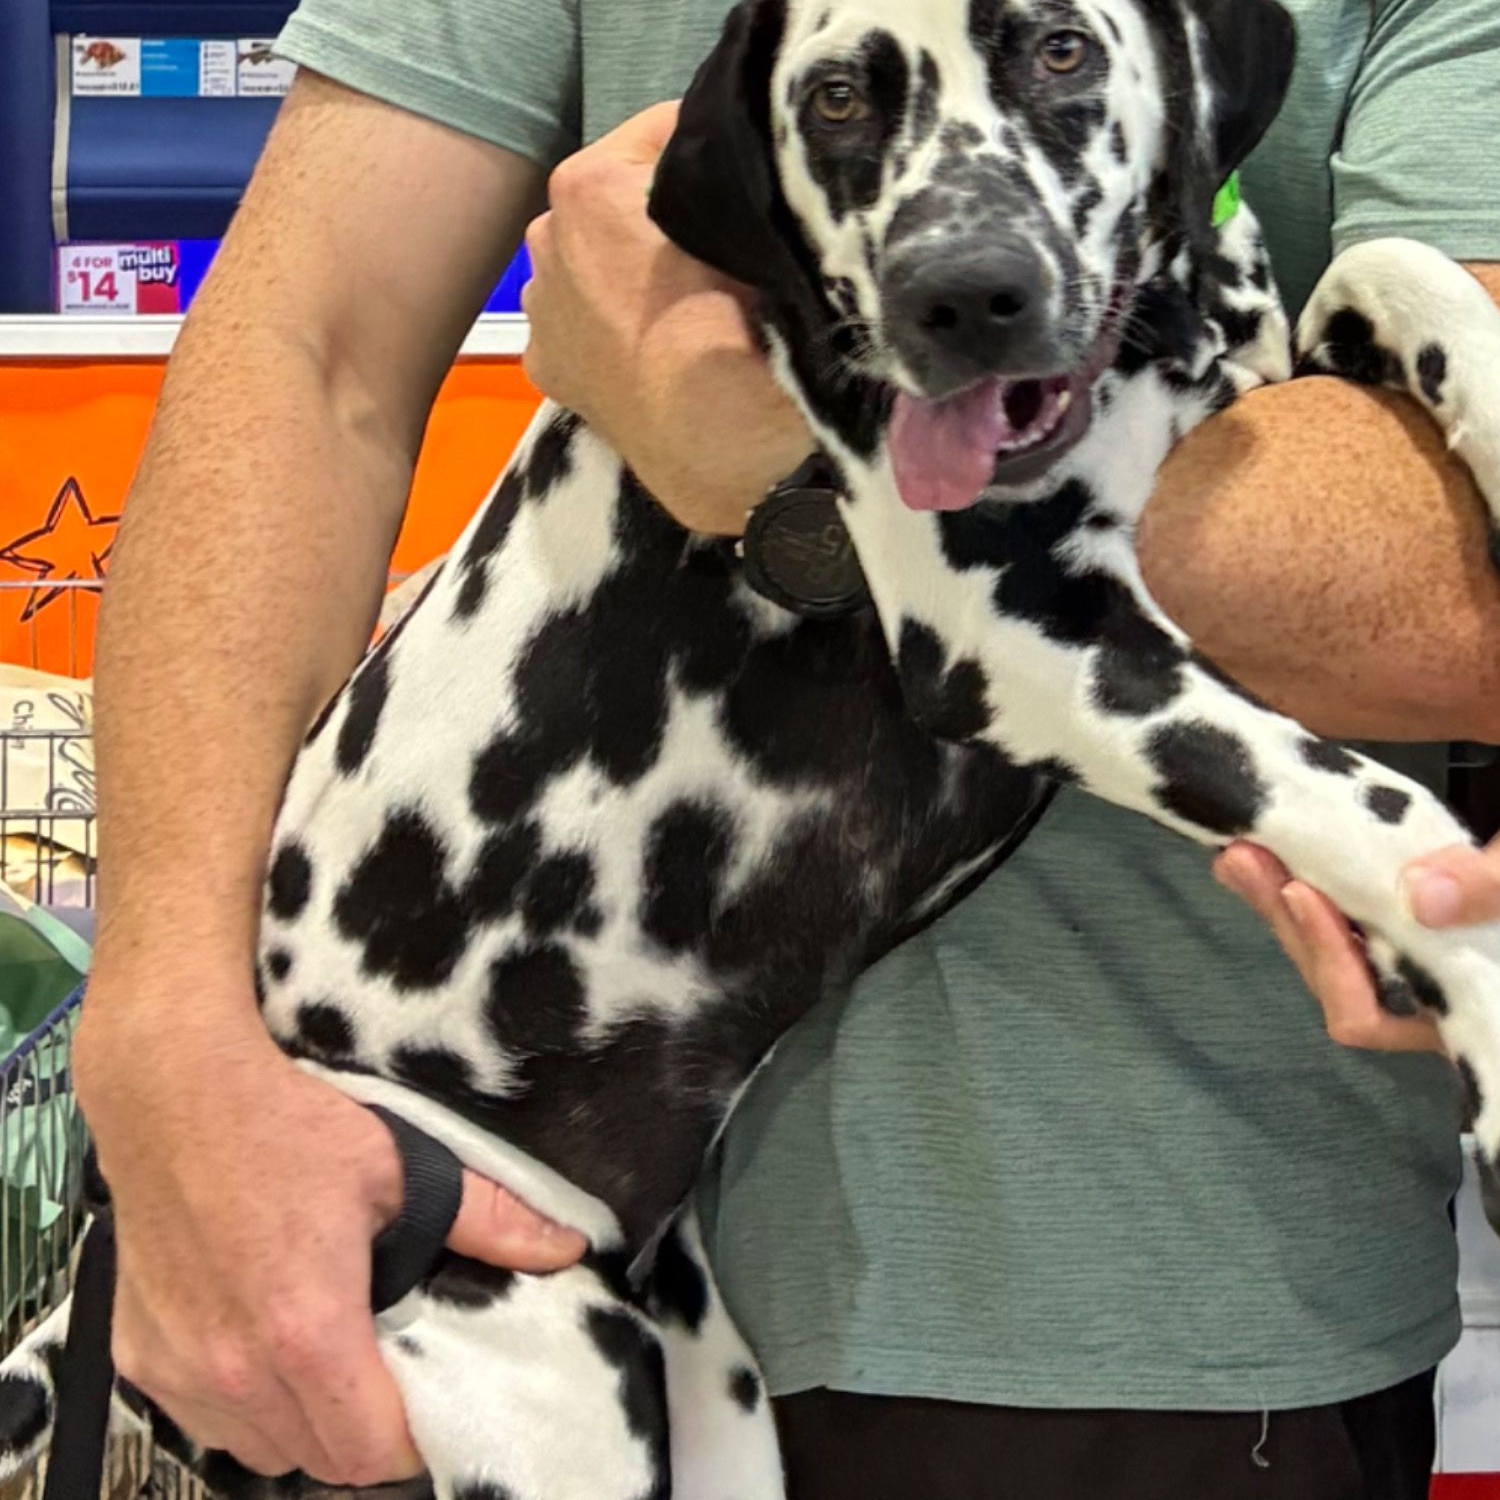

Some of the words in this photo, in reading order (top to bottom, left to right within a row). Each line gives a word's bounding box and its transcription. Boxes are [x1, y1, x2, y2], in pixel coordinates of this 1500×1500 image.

[71, 256, 81, 269] 4
[83, 256, 113, 269] FOR
[118, 245, 171, 268] multi
[140, 264, 177, 284] buy
[67, 271, 119, 302] $14
